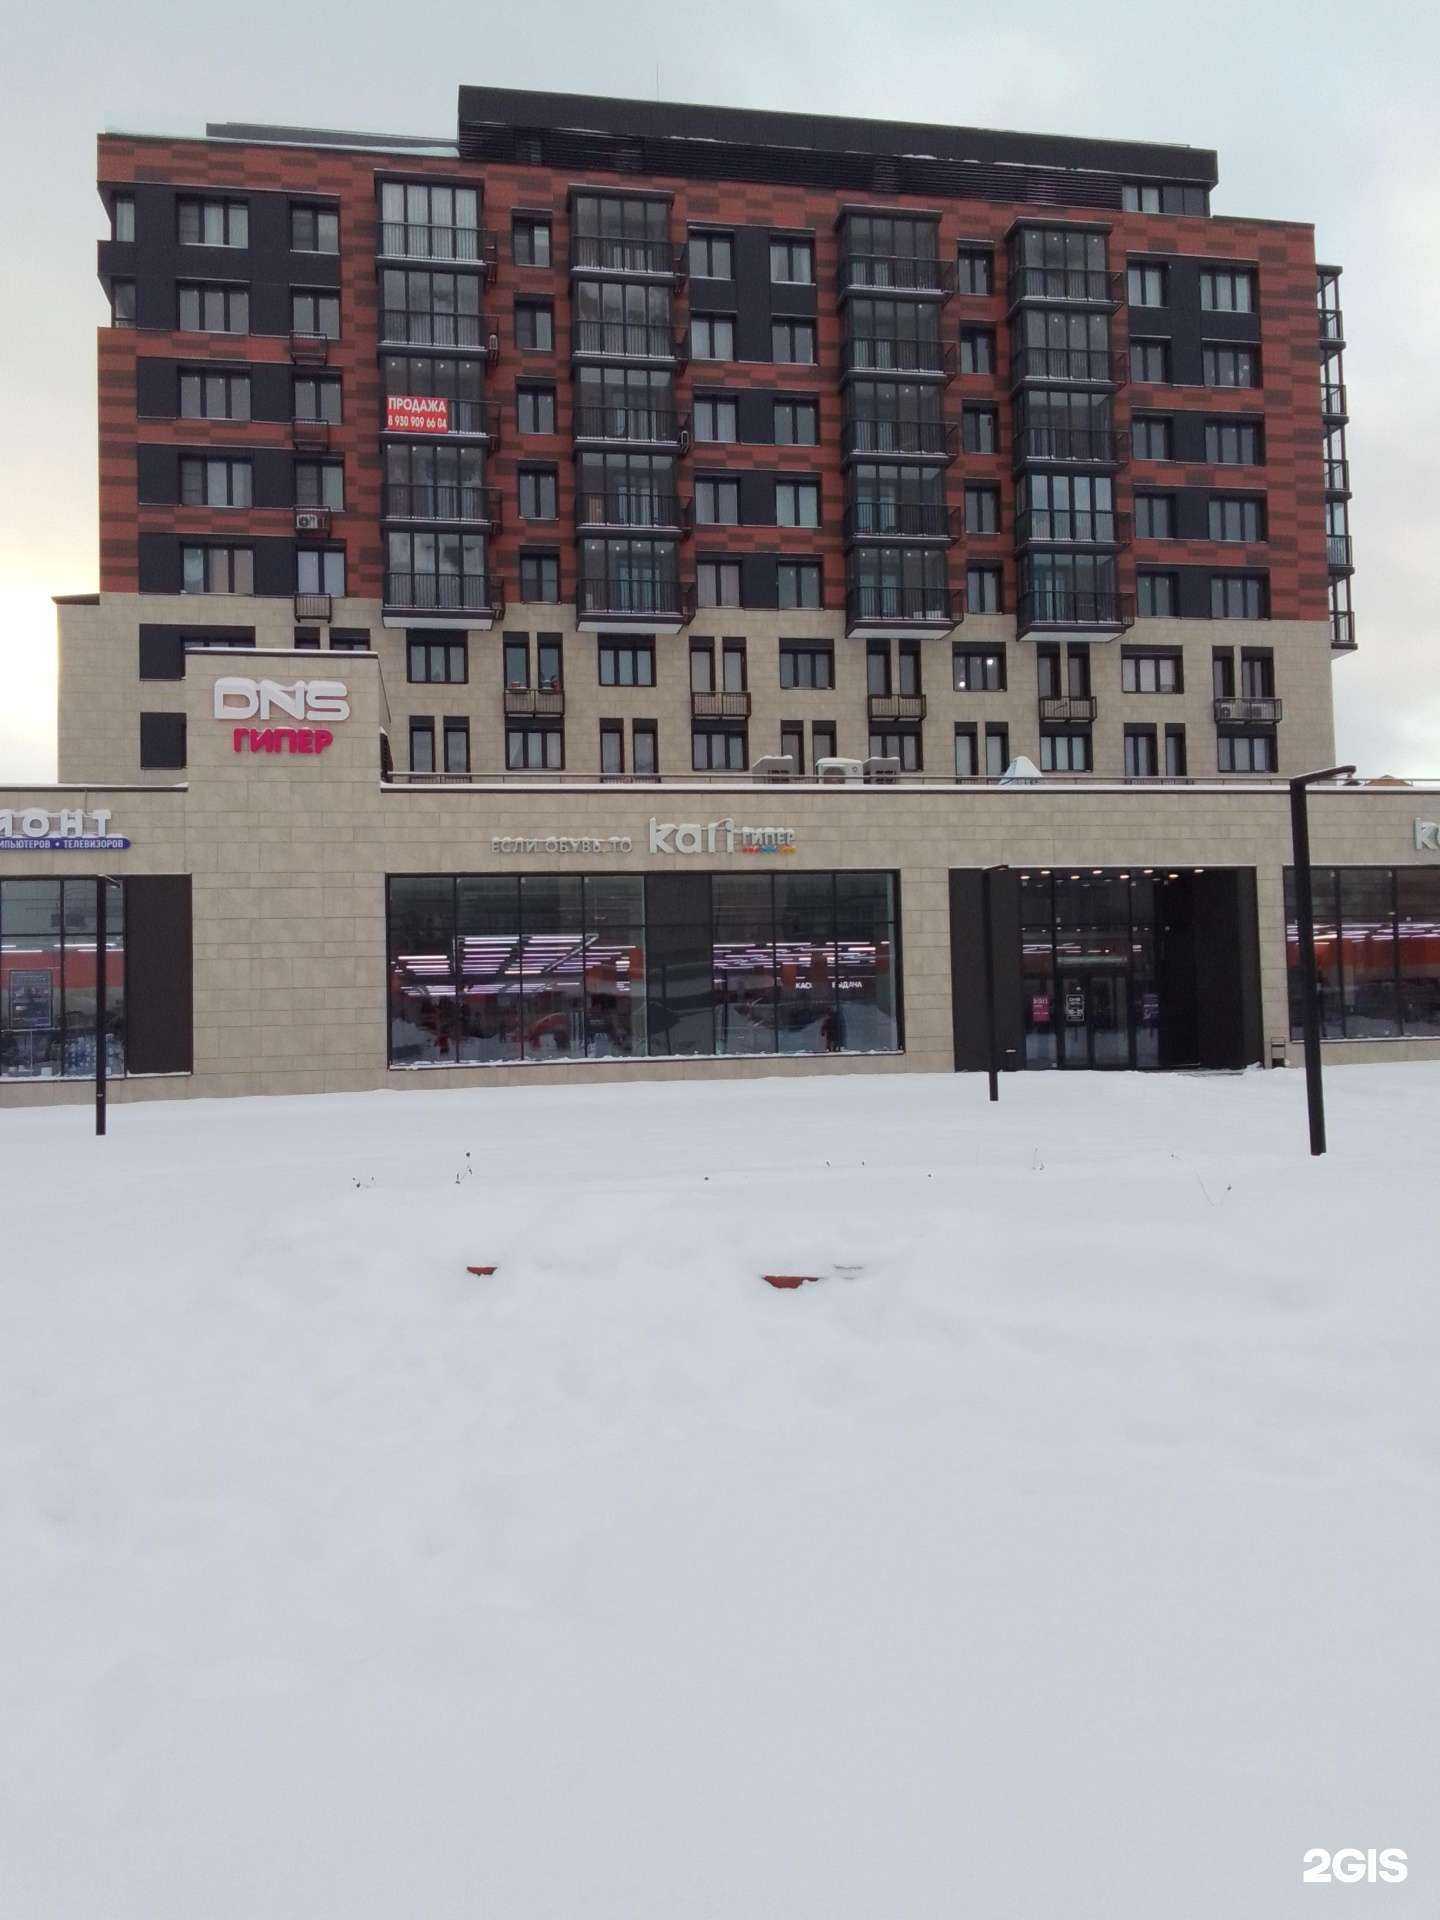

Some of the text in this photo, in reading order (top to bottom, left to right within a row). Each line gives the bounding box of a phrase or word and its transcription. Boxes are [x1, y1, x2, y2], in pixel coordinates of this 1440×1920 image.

[388, 397, 447, 413] ПРОДАЖА
[387, 415, 447, 428] 8 930 909 66 04
[214, 677, 350, 721] DNS
[232, 727, 334, 754] ГИПЕР
[63, 839, 124, 849] ТЕЛЕВИЗОРОВ
[649, 817, 735, 854] kari
[742, 827, 797, 845] ГИПЕР
[491, 836, 632, 854] ЕСЛИ ОБУВЬ ТО
